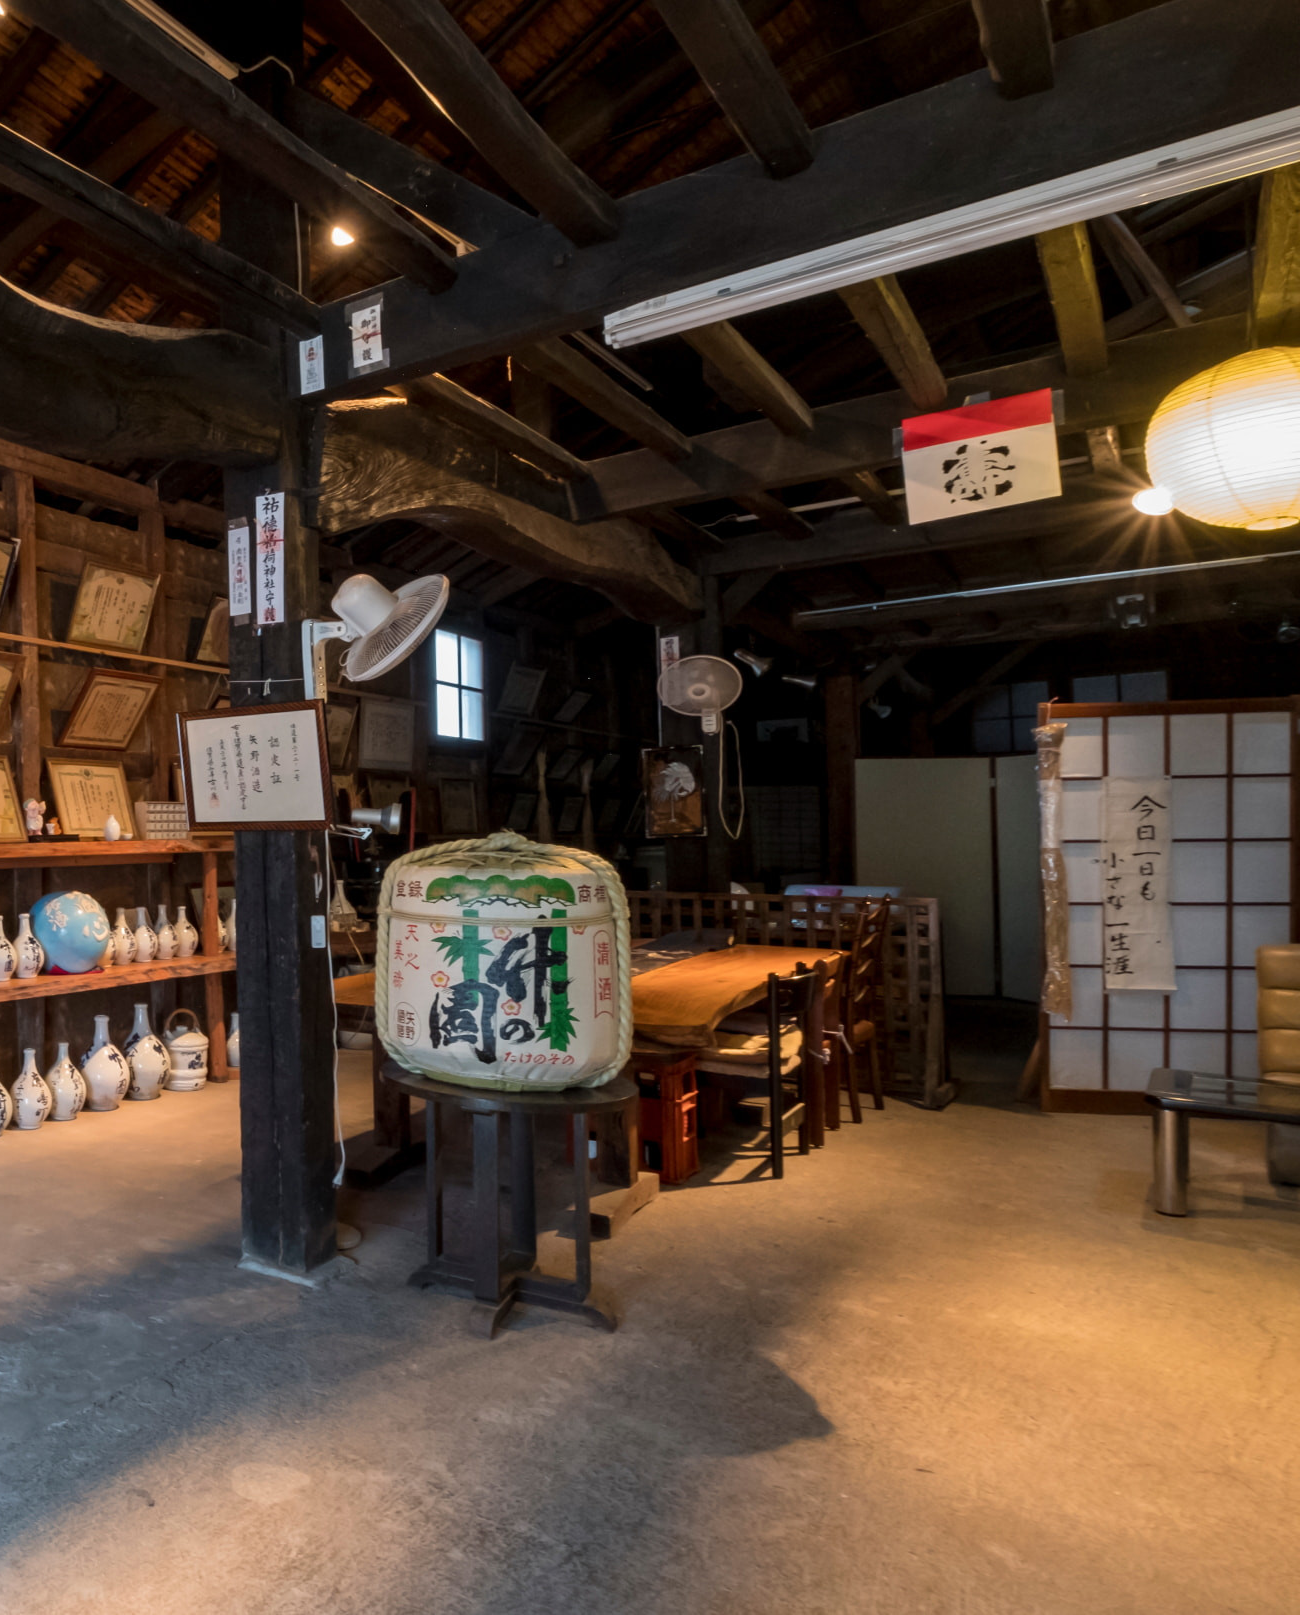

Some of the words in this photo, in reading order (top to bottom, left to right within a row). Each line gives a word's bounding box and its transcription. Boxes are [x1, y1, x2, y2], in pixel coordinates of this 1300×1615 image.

[1130, 795, 1168, 901] 今日一日も
[1103, 852, 1135, 975] 小さな一生涯
[428, 914, 569, 1065] 竹の園
[597, 941, 612, 1001] 清酒
[503, 1051, 576, 1065] たけのその
